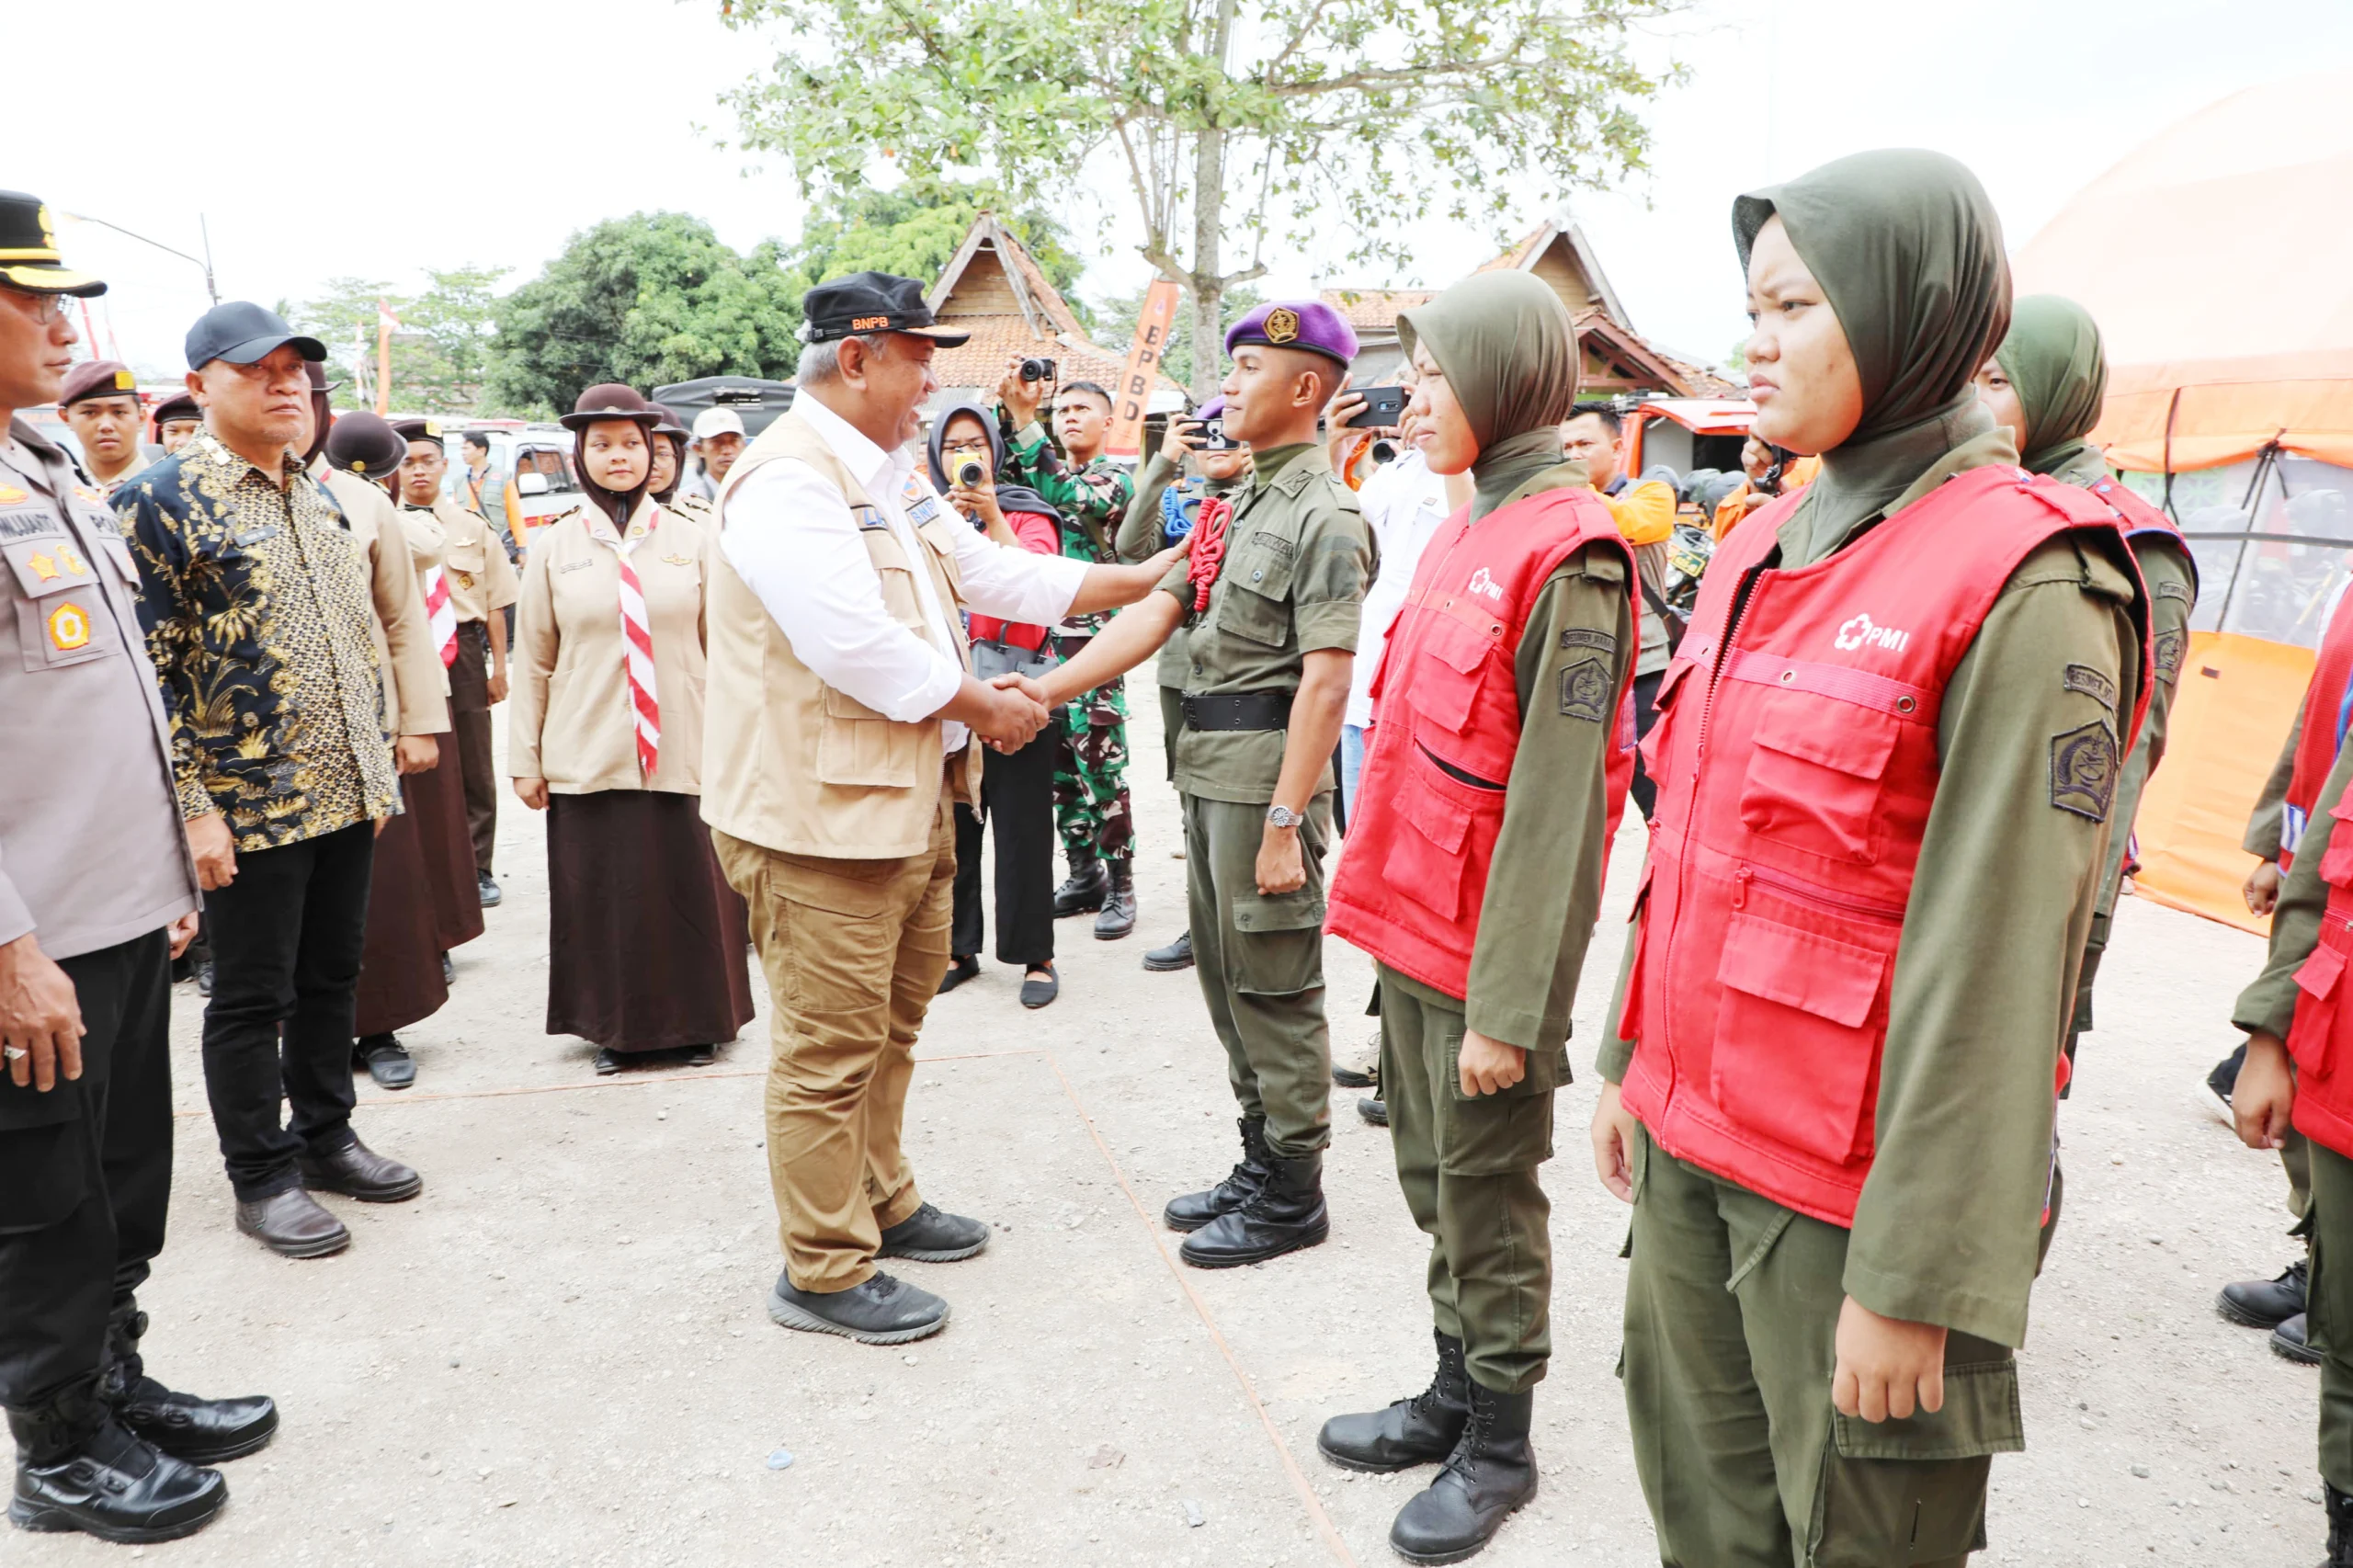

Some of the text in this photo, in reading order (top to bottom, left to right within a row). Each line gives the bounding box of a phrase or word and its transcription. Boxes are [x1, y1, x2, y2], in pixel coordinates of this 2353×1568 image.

[852, 316, 889, 331] BNPB
[1483, 580, 1504, 601] PMI
[1865, 626, 1910, 653] PMI
